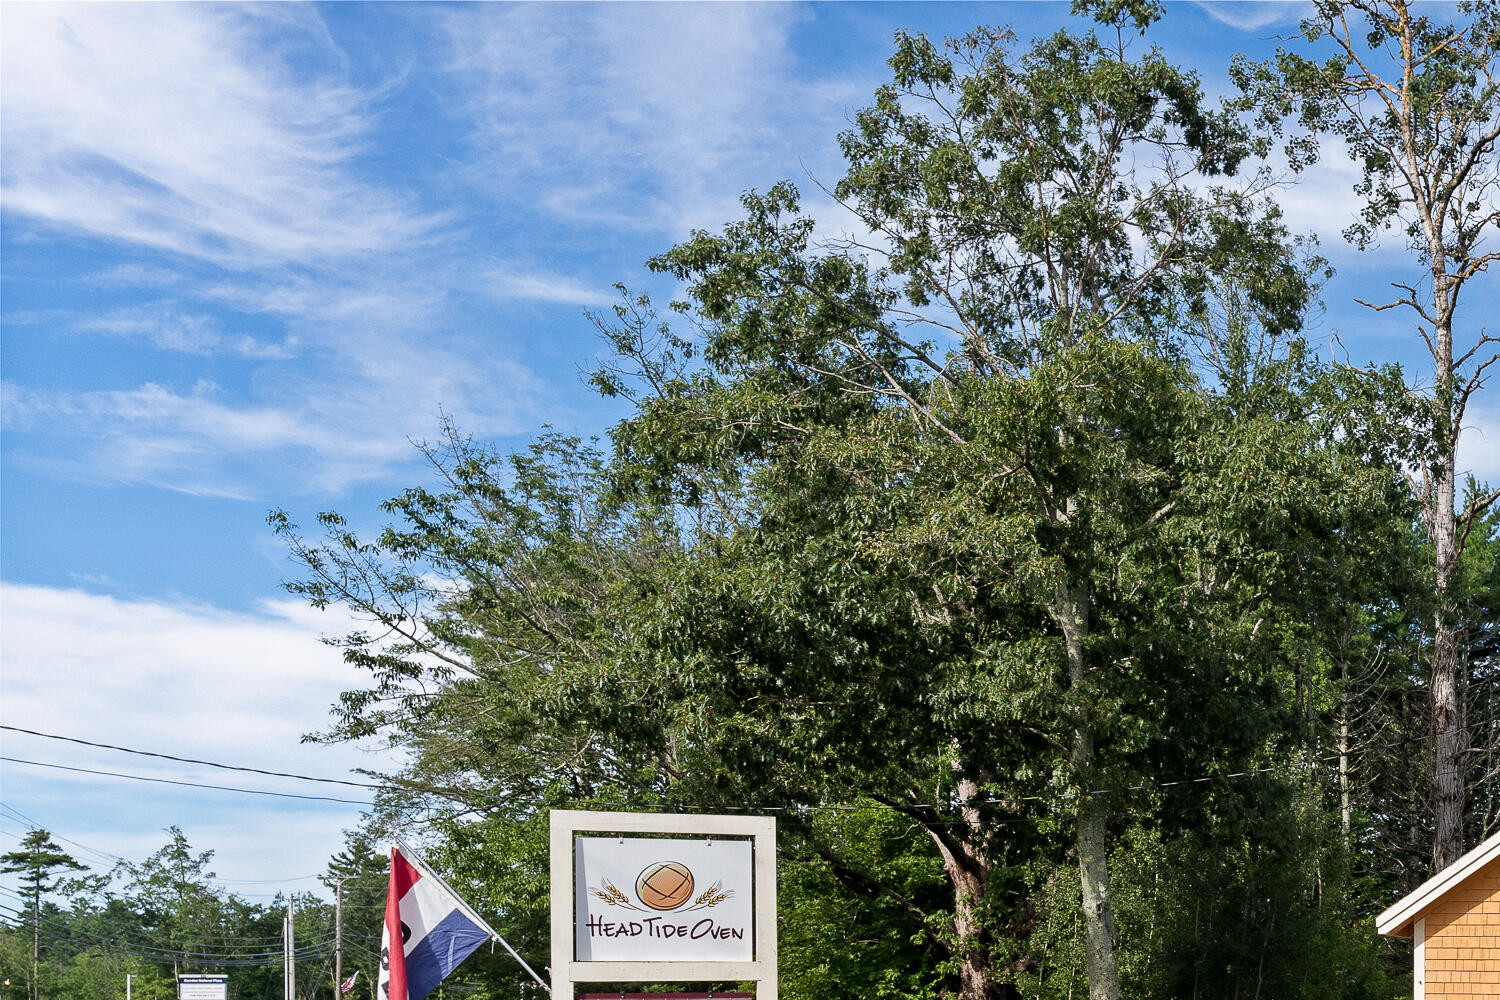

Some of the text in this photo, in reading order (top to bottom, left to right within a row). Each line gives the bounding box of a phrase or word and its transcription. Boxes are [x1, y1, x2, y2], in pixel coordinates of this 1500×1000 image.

[586, 914, 744, 940] HEAD TIDE OVEN
